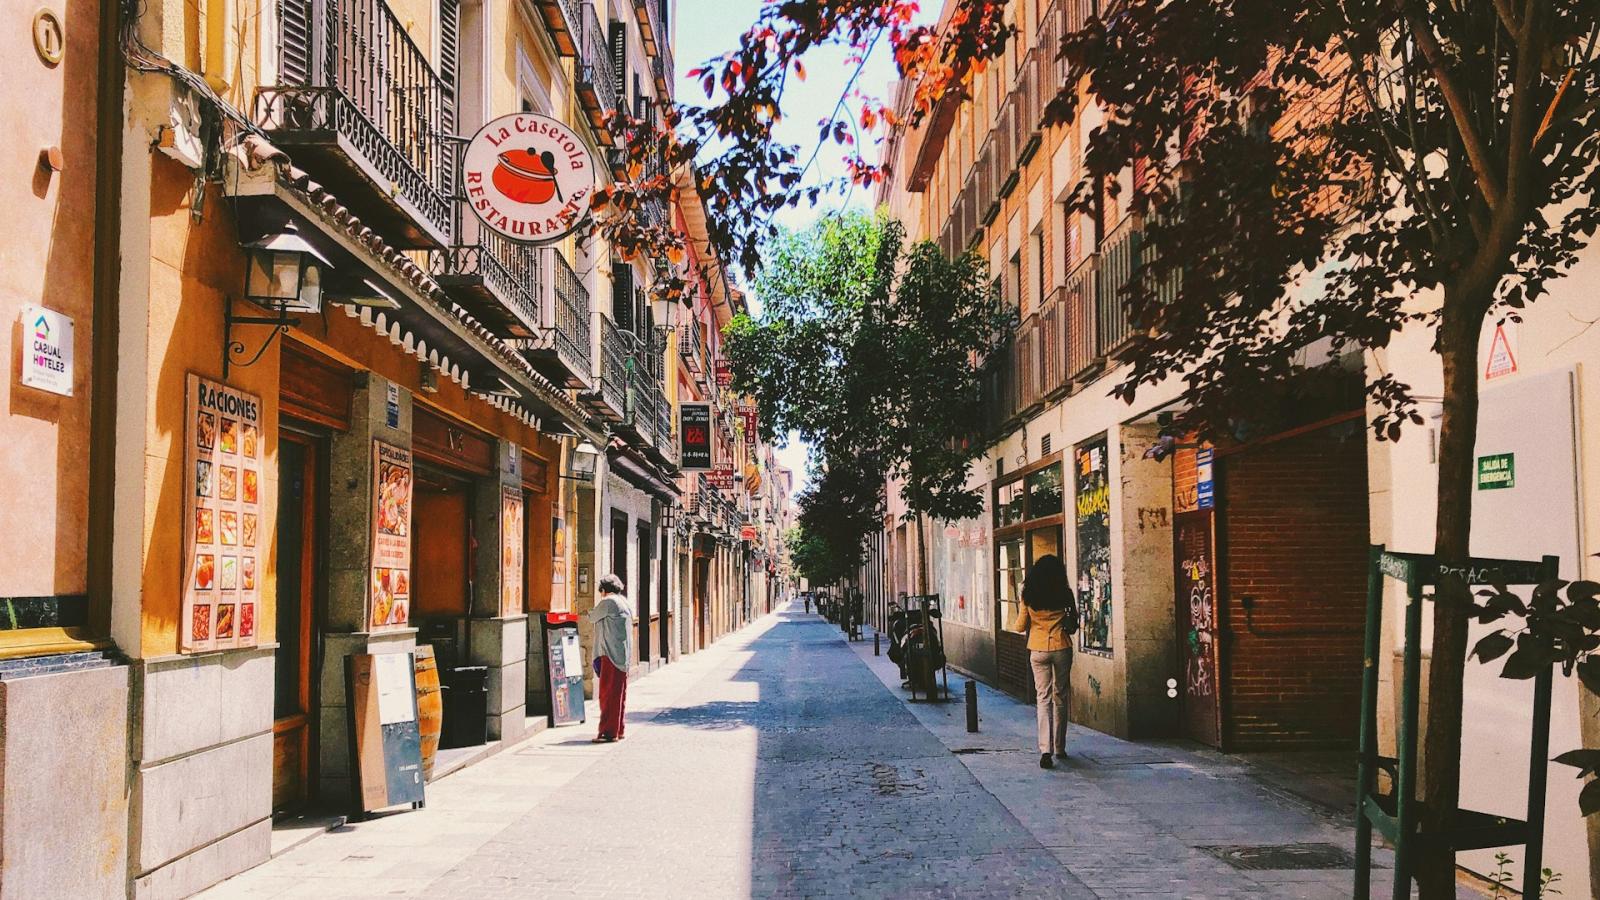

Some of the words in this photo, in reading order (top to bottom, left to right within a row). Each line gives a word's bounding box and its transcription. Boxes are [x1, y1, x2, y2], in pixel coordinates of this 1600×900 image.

[485, 126, 511, 148] La
[514, 116, 585, 171] Caserola
[33, 340, 62, 359] CASUAL
[33, 353, 65, 373] HOTELES
[198, 382, 257, 422] RACIONES
[1482, 460, 1501, 471] SALIDA
[1501, 458, 1509, 469] DE
[1480, 470, 1512, 483] EMERGENCIA
